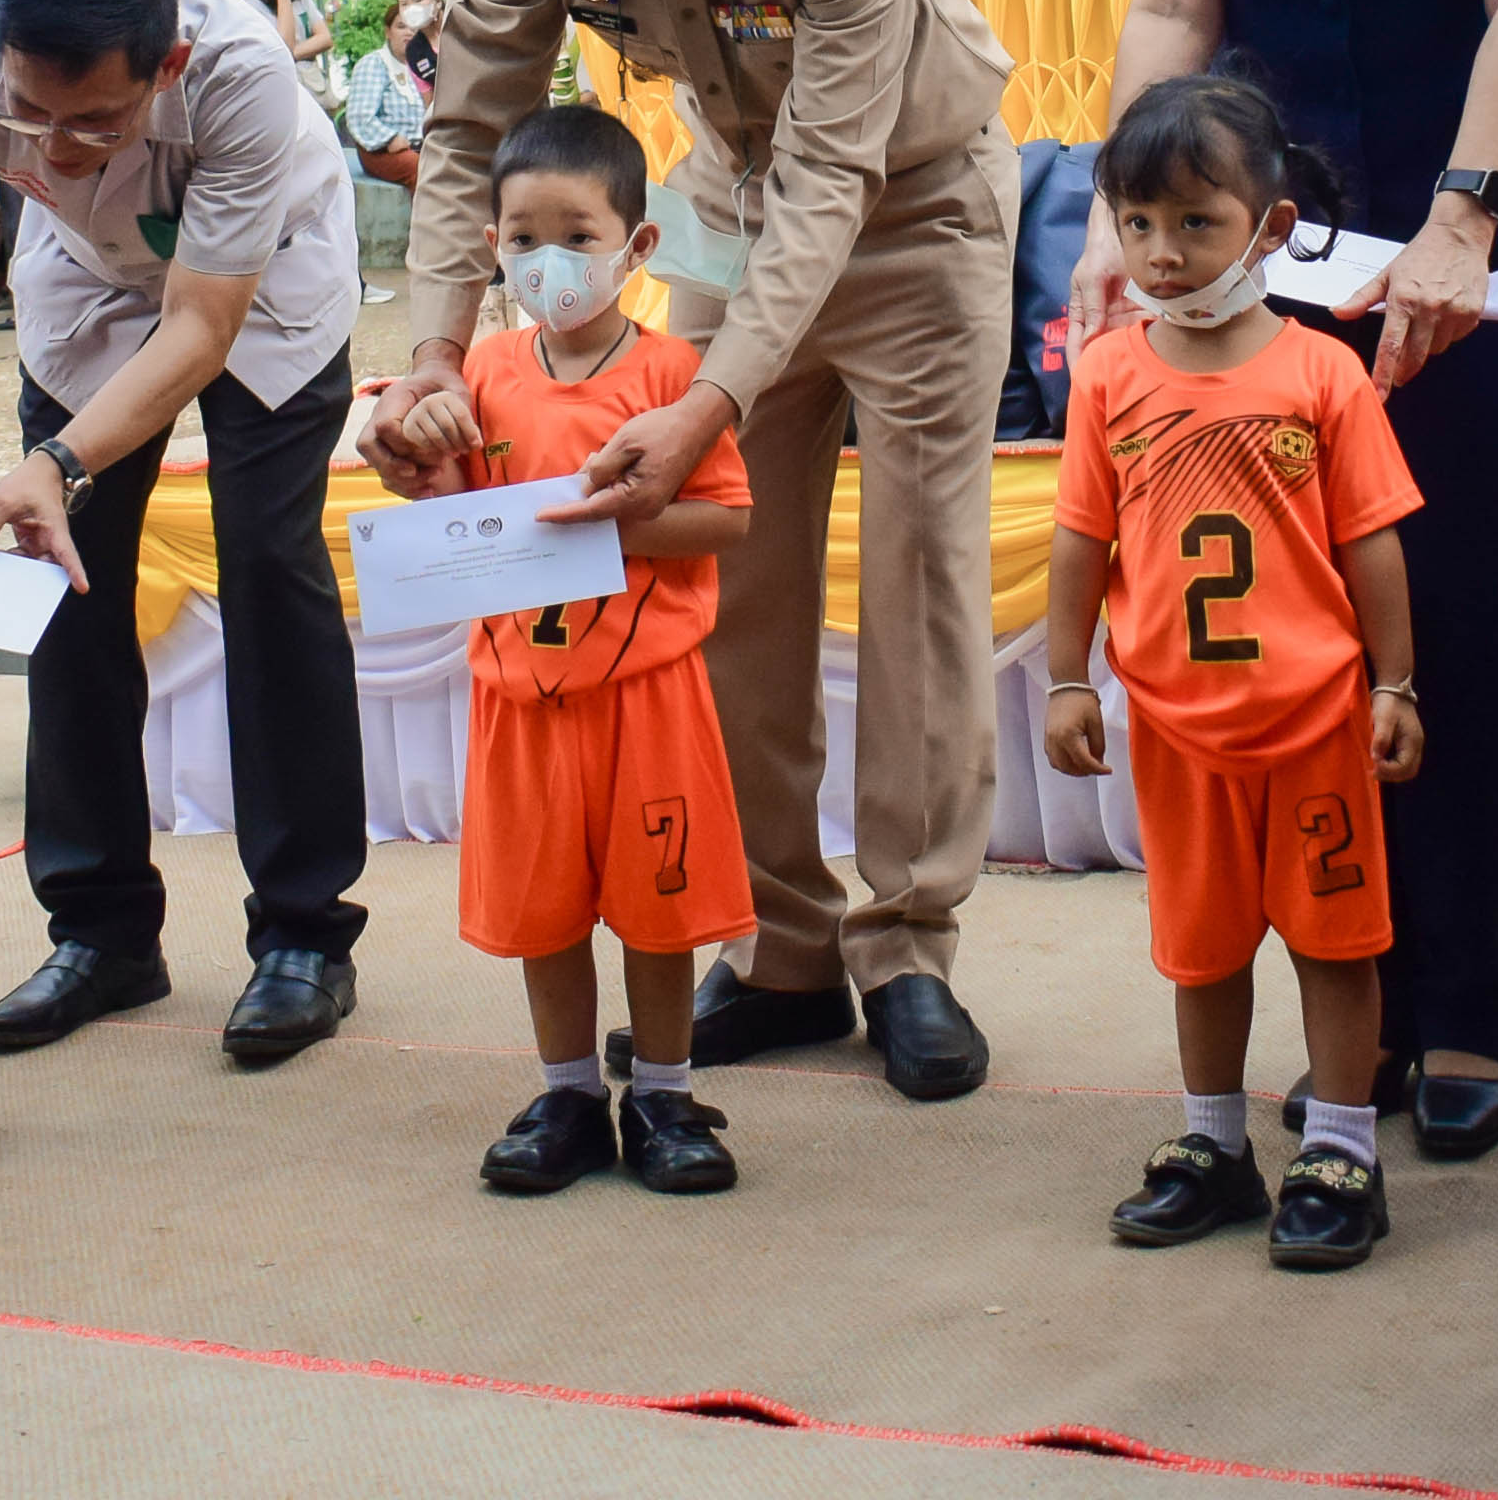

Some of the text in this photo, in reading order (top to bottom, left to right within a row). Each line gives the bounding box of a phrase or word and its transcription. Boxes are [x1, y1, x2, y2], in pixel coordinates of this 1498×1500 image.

[1179, 510, 1261, 664] 2
[642, 795, 689, 896] 7
[1296, 792, 1365, 897] 2
